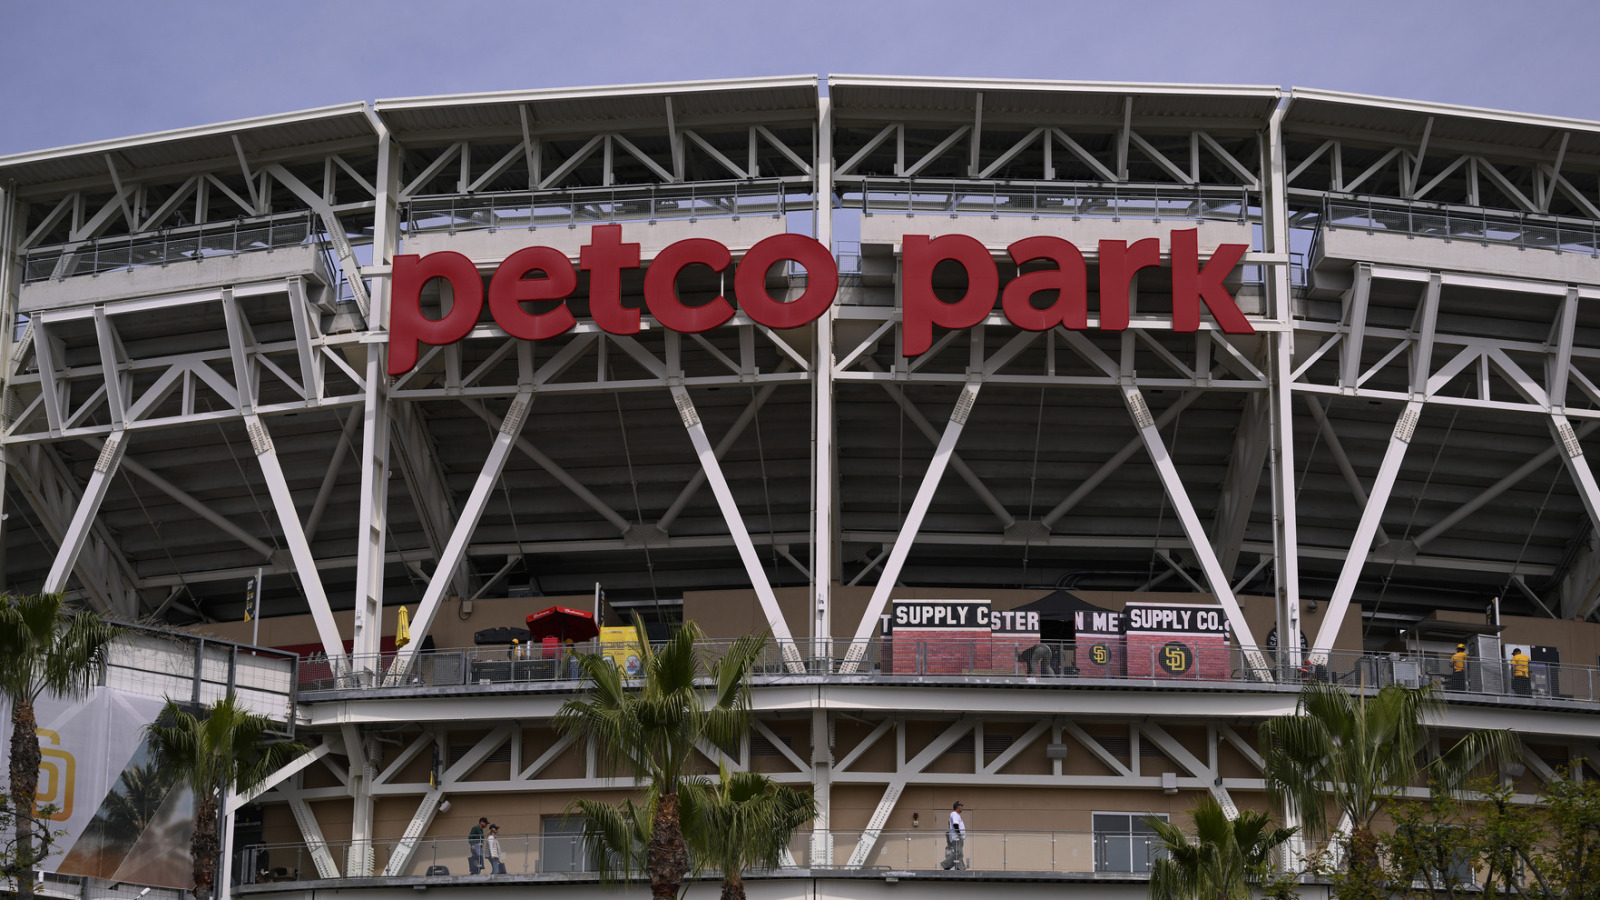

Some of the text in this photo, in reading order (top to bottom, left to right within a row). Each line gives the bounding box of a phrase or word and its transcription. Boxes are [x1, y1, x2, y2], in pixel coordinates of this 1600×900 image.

[388, 224, 1256, 376] petco park
[896, 606, 969, 624] SUPPLY
[991, 611, 1039, 631] STER
[1130, 609, 1192, 630] SUPPLY
[1196, 611, 1224, 631] CO.
